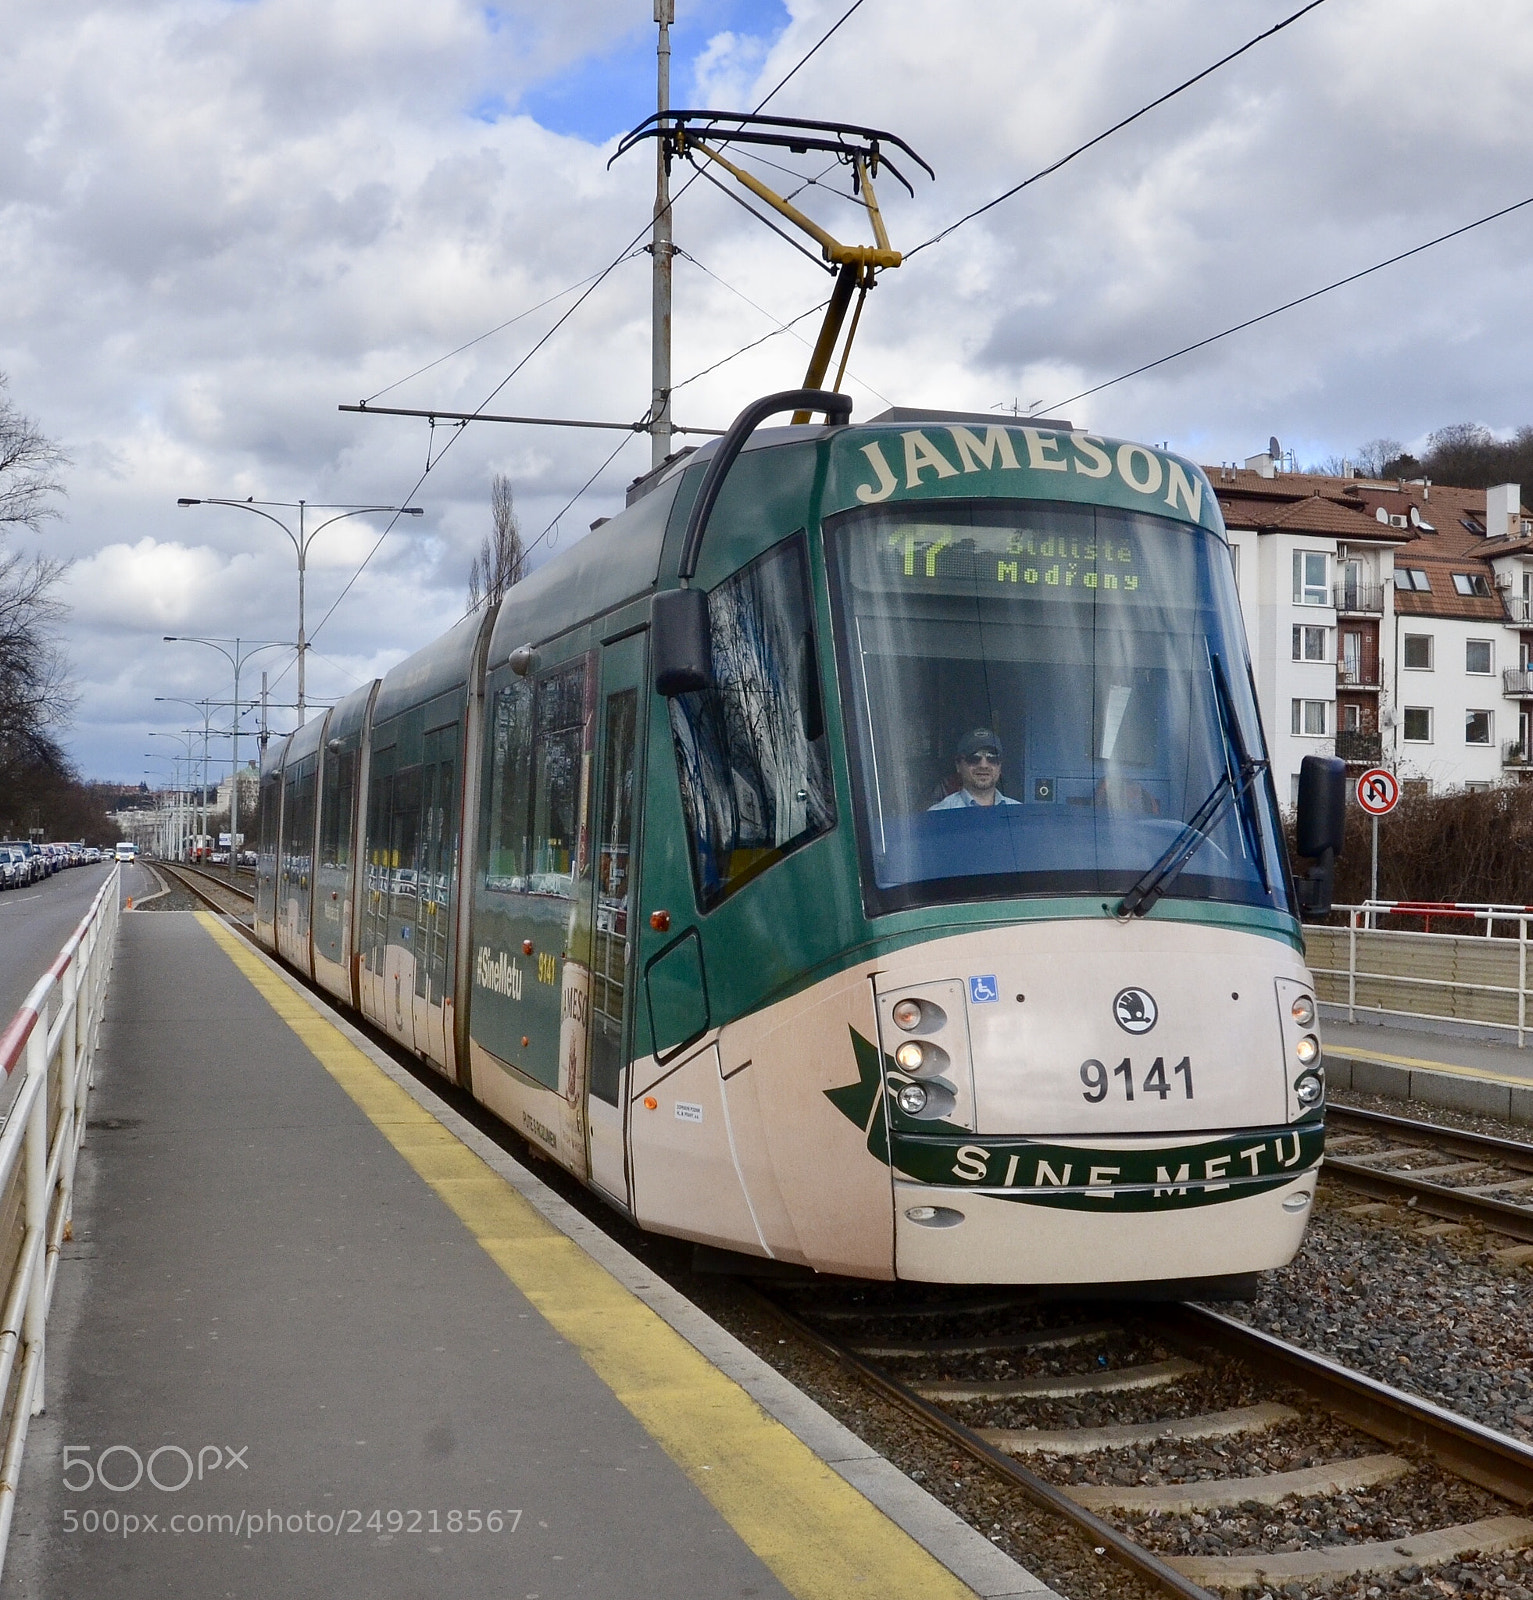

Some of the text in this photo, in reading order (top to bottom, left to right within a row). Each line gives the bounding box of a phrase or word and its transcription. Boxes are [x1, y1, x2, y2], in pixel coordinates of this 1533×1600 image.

[856, 426, 1203, 523] JAMESON
[888, 528, 952, 577] 17
[997, 560, 1139, 591] Modřany
[538, 952, 556, 986] 9141
[1079, 1056, 1195, 1104] 9141
[951, 1131, 1301, 1198] SINE METU
